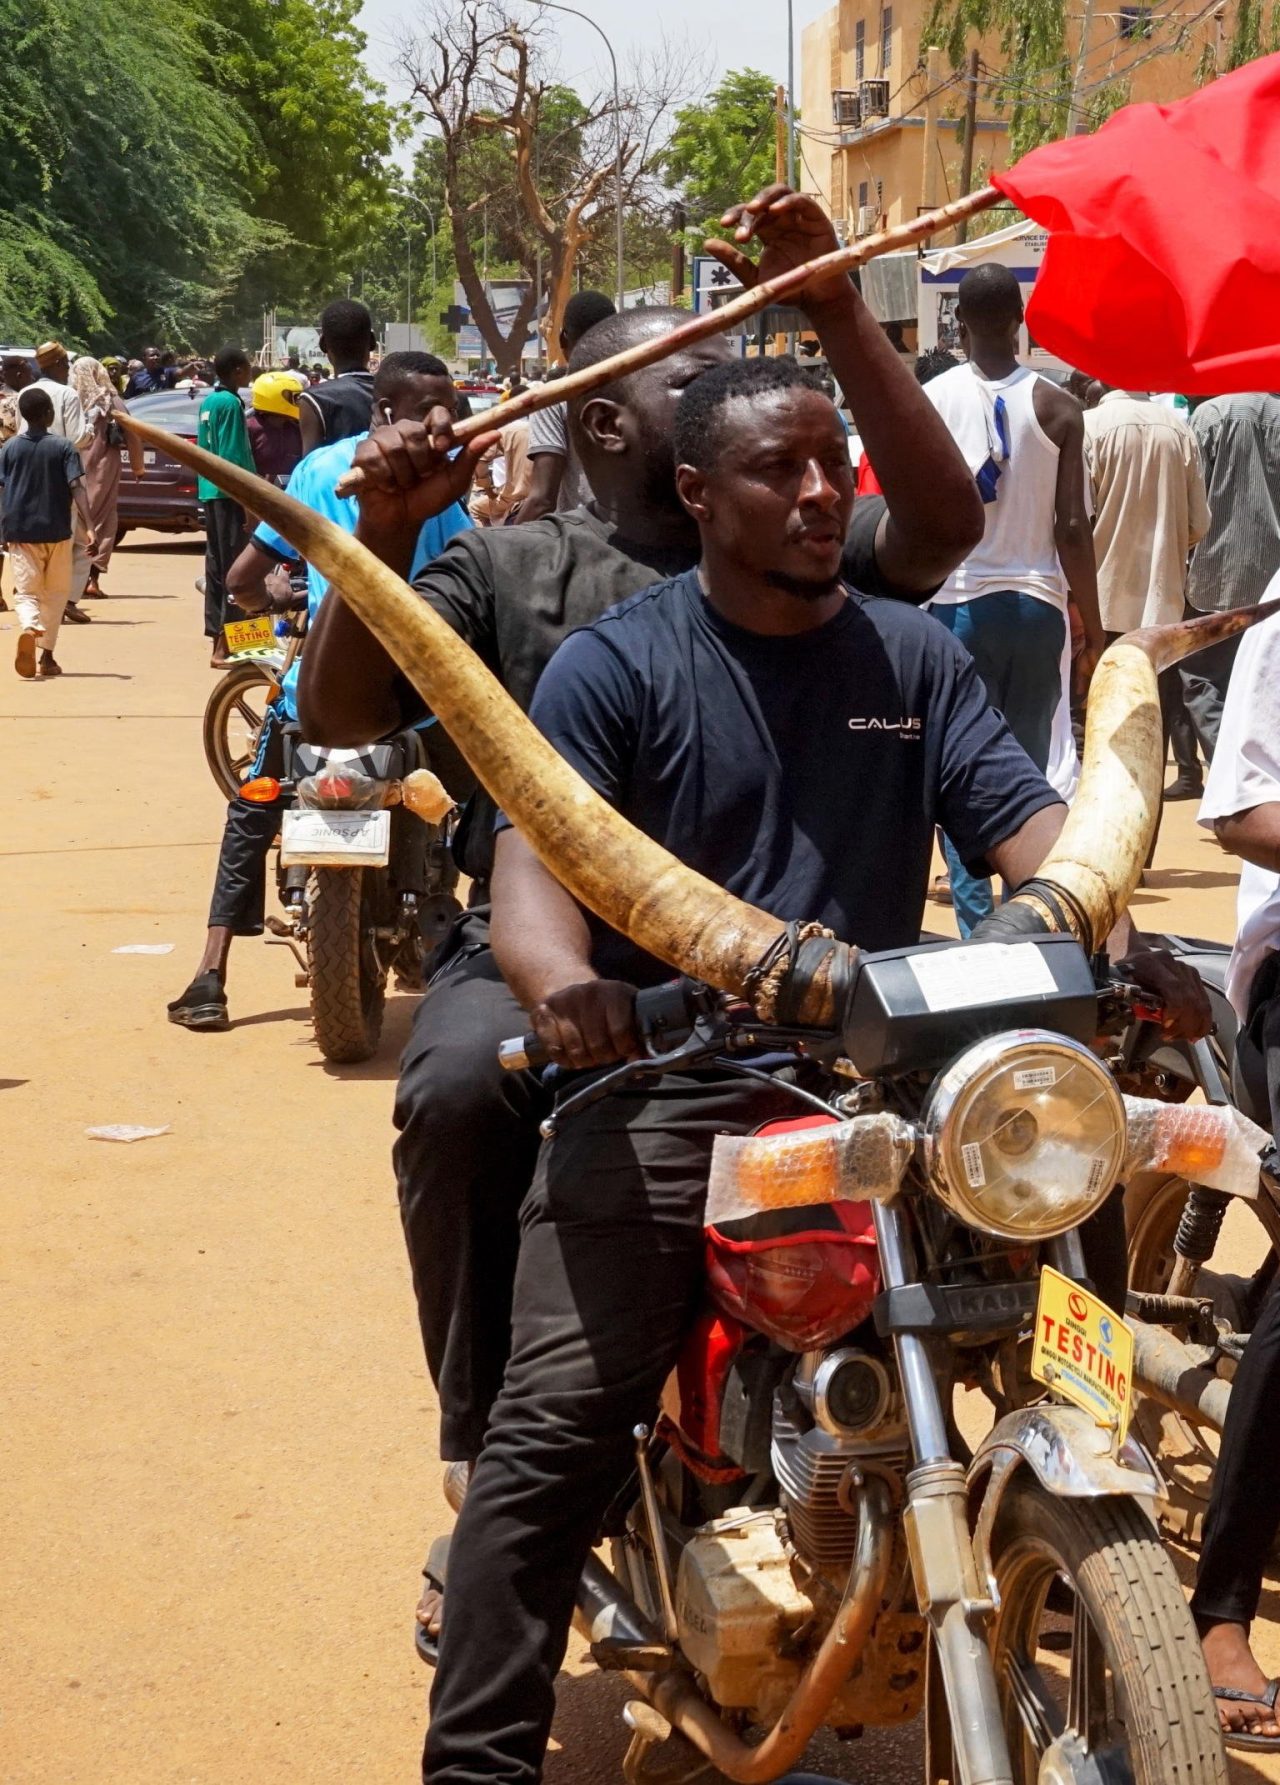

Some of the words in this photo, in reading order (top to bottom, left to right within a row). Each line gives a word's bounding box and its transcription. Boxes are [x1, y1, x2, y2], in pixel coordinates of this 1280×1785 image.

[228, 629, 270, 644] TESTING
[848, 716, 921, 730] CALUS
[1042, 1314, 1126, 1402] TESTING
